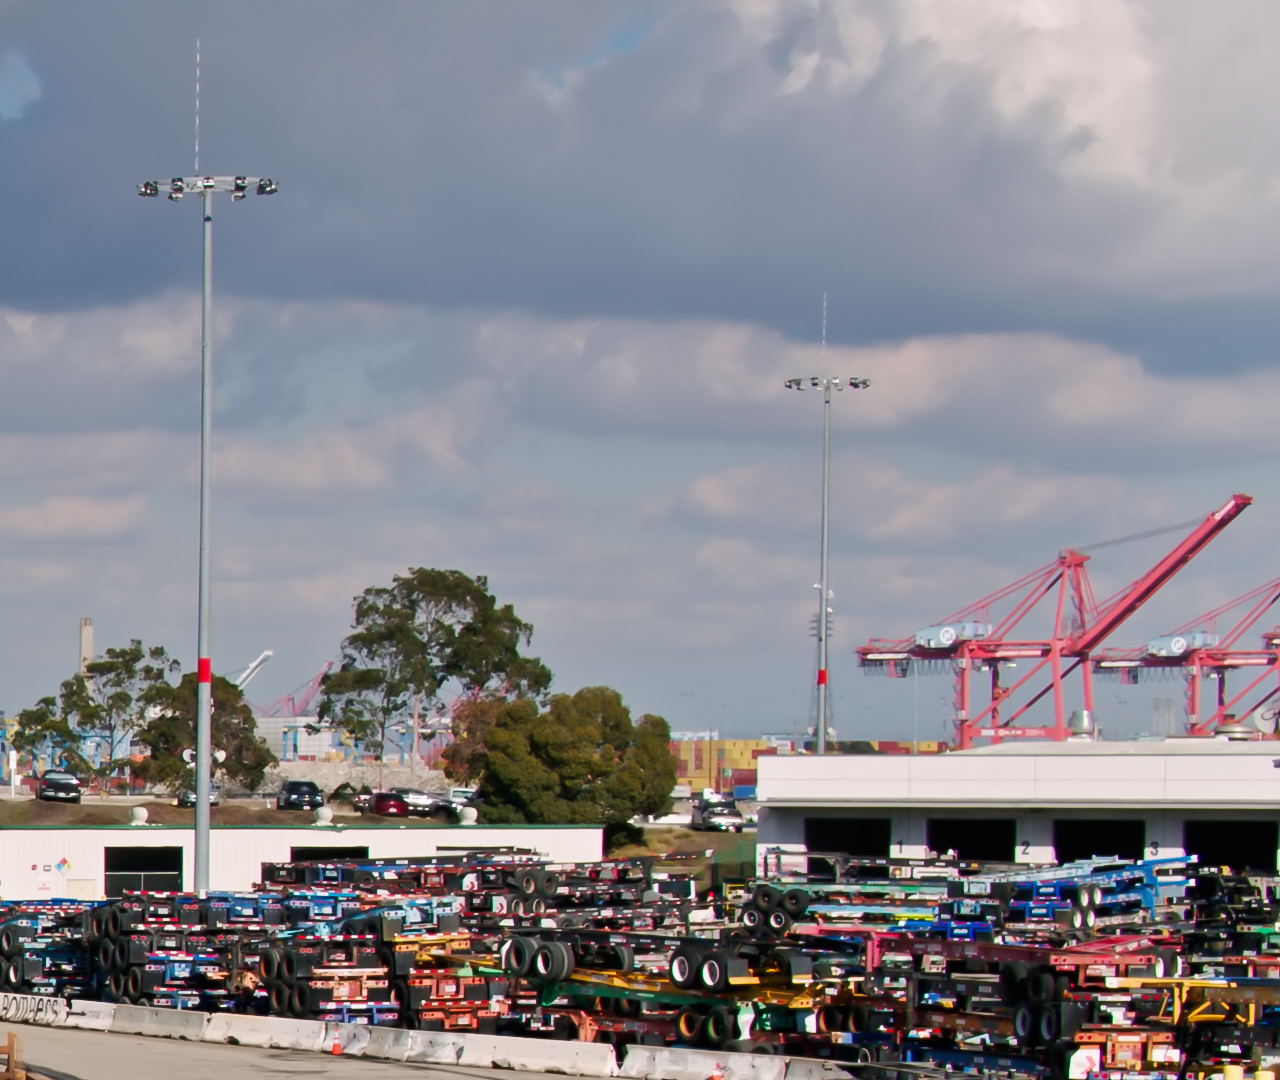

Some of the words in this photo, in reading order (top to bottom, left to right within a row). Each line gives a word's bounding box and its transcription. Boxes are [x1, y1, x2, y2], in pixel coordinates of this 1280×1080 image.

[898, 840, 903, 854] 1
[1021, 841, 1030, 855] 2
[1150, 841, 1159, 856] 3
